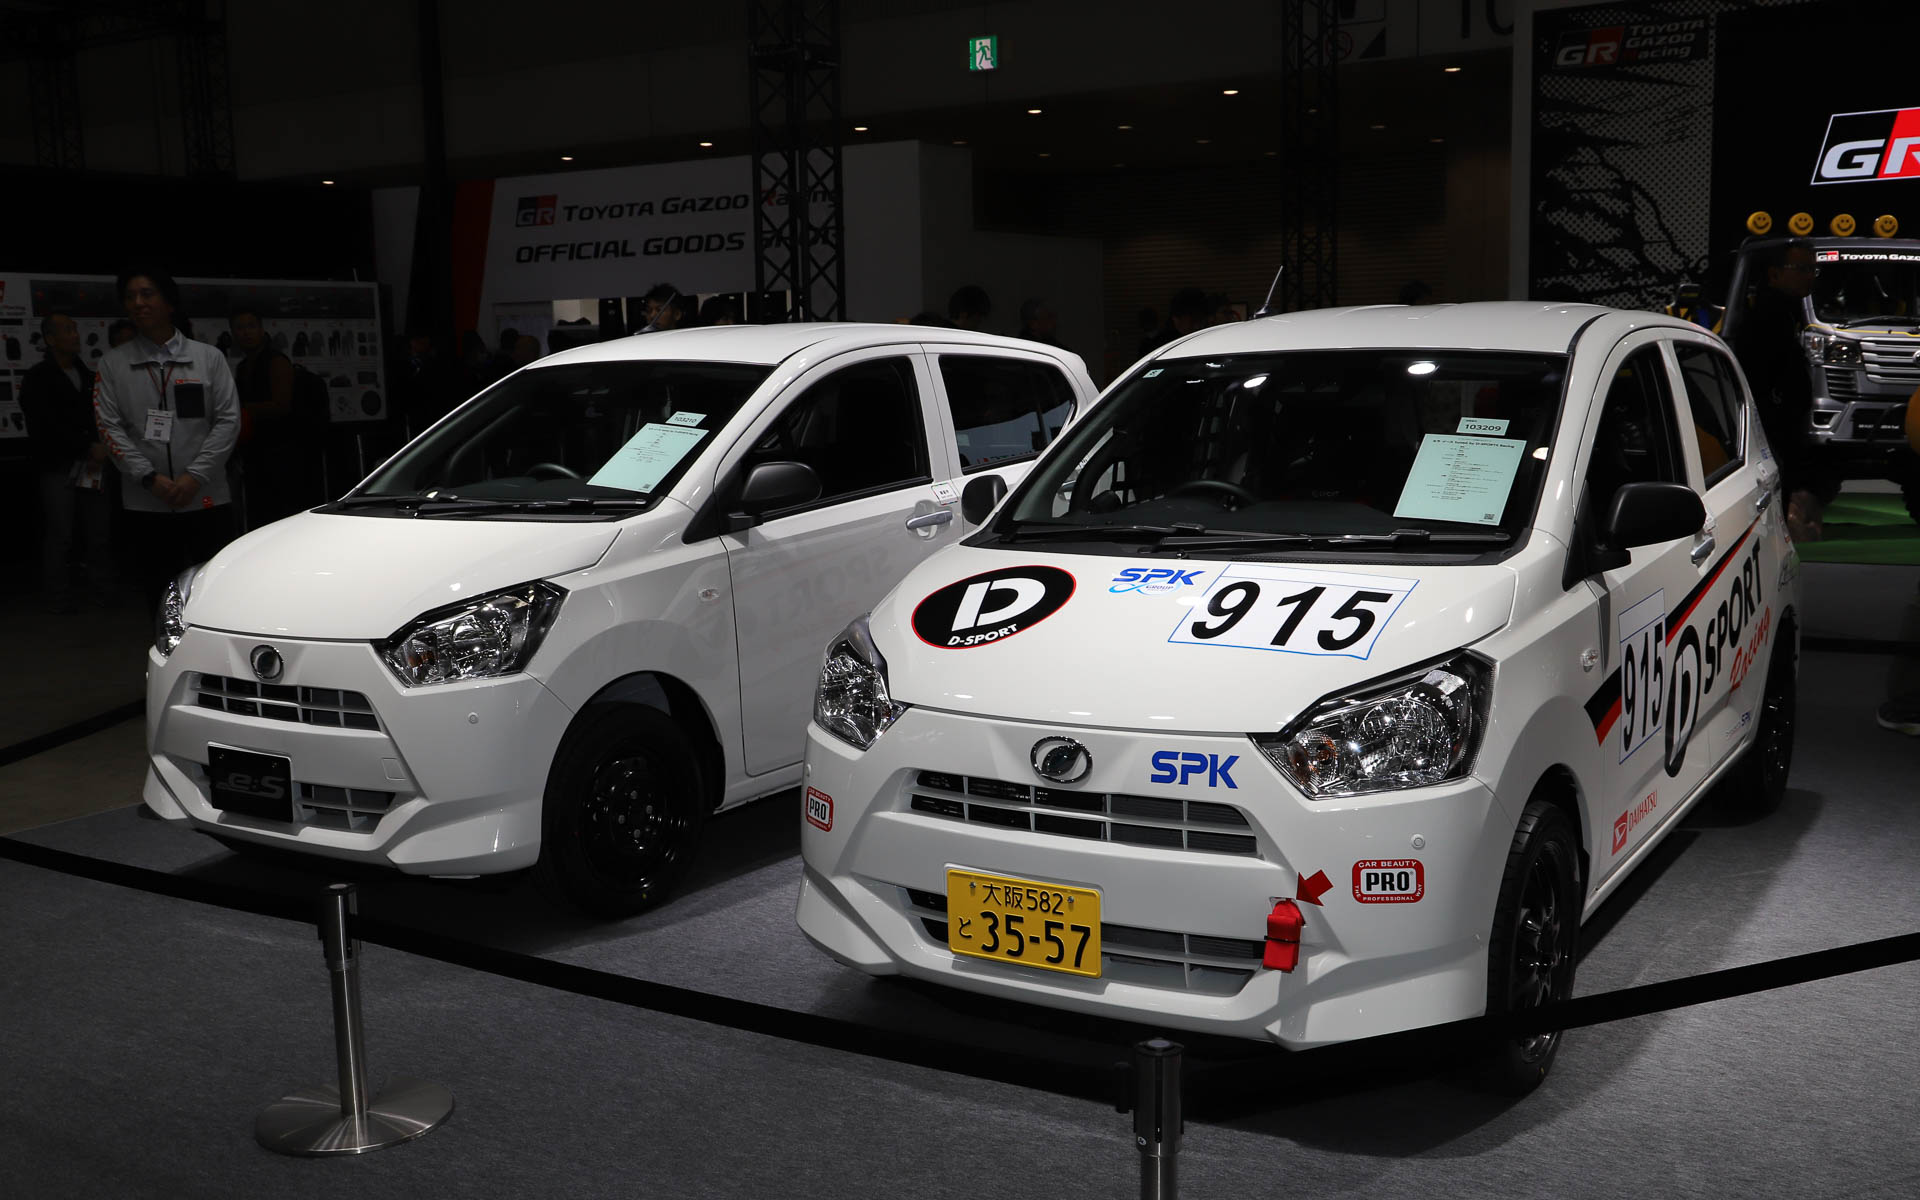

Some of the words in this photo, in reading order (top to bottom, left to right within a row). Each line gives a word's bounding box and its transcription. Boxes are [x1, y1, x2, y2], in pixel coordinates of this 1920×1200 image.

[1629, 19, 1705, 37] TOYOTA
[1556, 41, 1618, 66] GR
[1624, 33, 1696, 49] GAZOO
[517, 204, 556, 226] GR
[563, 201, 654, 222] TOYOTA
[662, 194, 749, 214] GAZOO
[516, 240, 636, 263] OFFICIAL
[643, 232, 746, 256] GOODS
[1840, 253, 1888, 262] TOYOTA
[1465, 423, 1502, 432] 103209
[1112, 568, 1206, 585] SPK
[1191, 581, 1394, 651] 915
[1704, 537, 1762, 694] SPORT
[947, 624, 1018, 646] D-SPORT
[1623, 621, 1664, 752] 915
[1151, 751, 1240, 789] SPK
[809, 798, 827, 820] PRO
[1629, 790, 1657, 832] DAIHATSU
[1366, 871, 1410, 892] PRO
[958, 917, 973, 939] と
[980, 911, 1091, 968] 35-57
